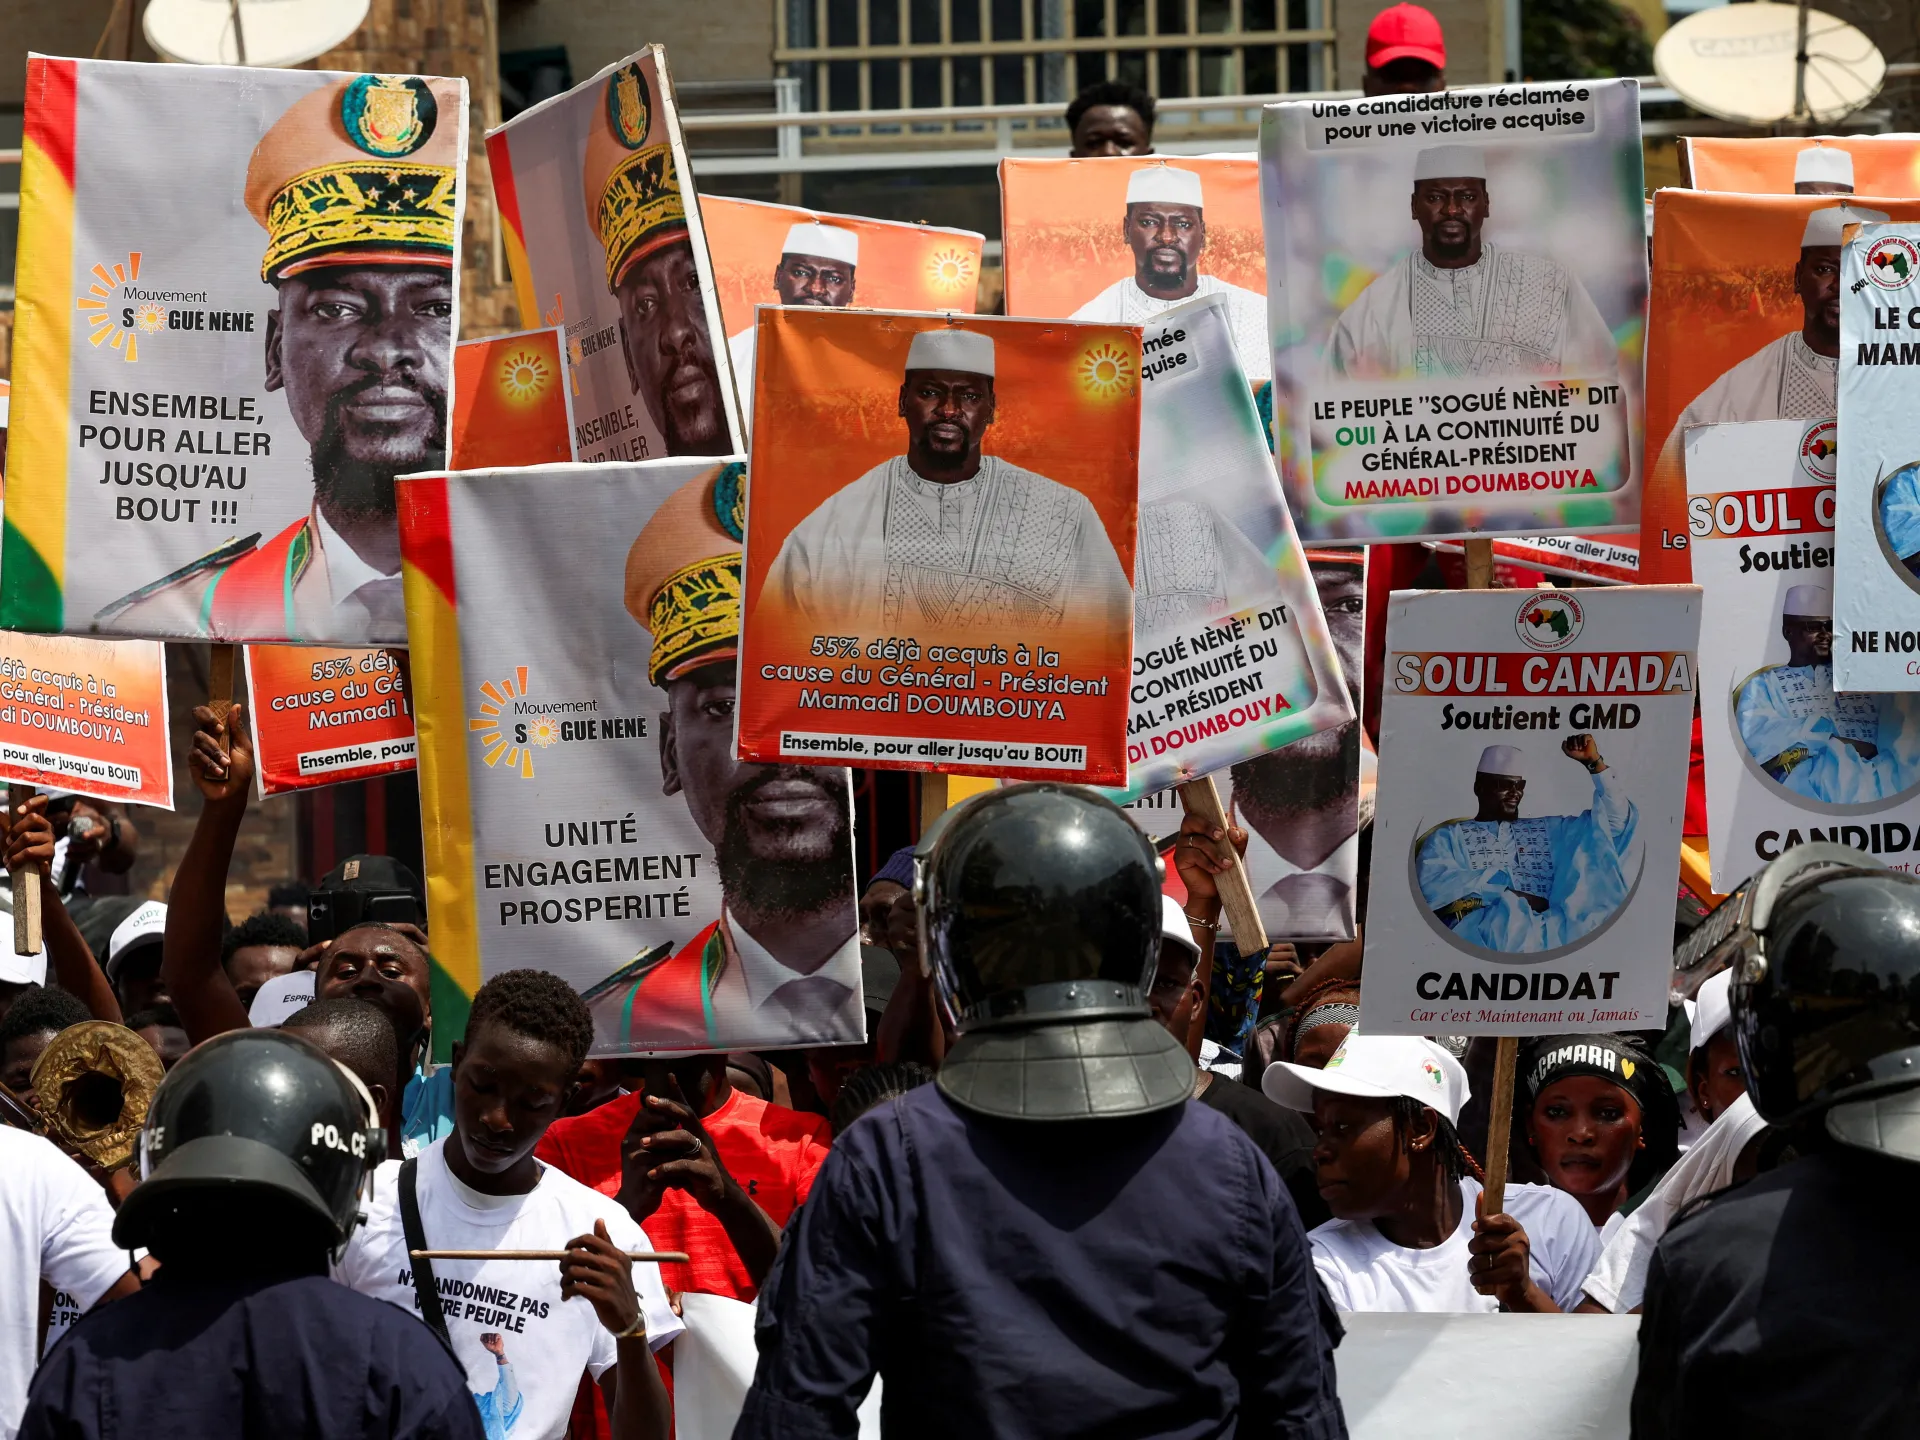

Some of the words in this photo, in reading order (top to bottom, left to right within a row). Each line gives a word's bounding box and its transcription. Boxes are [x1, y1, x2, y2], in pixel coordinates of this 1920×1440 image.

[1312, 102, 1351, 119] Une
[1356, 90, 1483, 116] candidature
[1488, 84, 1590, 109] réclamée
[1325, 124, 1372, 144] pour
[1377, 120, 1416, 137] une
[1421, 113, 1497, 135] victoire
[1502, 108, 1586, 133] acquise
[123, 286, 208, 303] Mouvement
[1850, 278, 1869, 295] SOUL
[565, 316, 594, 338] ouvement
[1874, 307, 1900, 330] LE
[89, 390, 264, 425] ENSEMBLE,
[1314, 401, 1336, 420] LE
[1341, 396, 1414, 419] PEUPLE
[1587, 385, 1619, 406] DIT
[79, 424, 166, 453] POUR
[174, 430, 271, 456] ALLER
[575, 404, 639, 450] NSEMBLE,
[1335, 426, 1376, 446] OUI
[1382, 420, 1399, 443] À
[1405, 423, 1431, 442] LA
[1437, 410, 1564, 441] CONTINUITÉ
[1570, 413, 1600, 434] DU
[1361, 441, 1577, 472] GÉNÉRAL-PRÉSIDENT
[99, 461, 247, 491] JUSQU'AU
[1344, 476, 1439, 500] MAMADI
[1445, 468, 1598, 495] DOUMBOUYA
[116, 496, 201, 523] BOUT
[211, 500, 238, 525] !!!
[1687, 493, 1801, 537] SOUL
[1538, 535, 1571, 551] pour
[1574, 542, 1603, 558] aller
[1661, 530, 1688, 550] Le
[1257, 605, 1289, 631] DIT
[810, 636, 861, 659] 55%
[866, 638, 922, 664] déjà
[928, 645, 1008, 669] acquis
[1013, 643, 1031, 666] à
[1036, 647, 1060, 668] la
[1851, 631, 1879, 653] NE
[31, 668, 83, 692] acquis
[87, 674, 98, 695] à
[101, 679, 116, 699] la
[311, 657, 355, 681] 55%
[760, 663, 834, 684] cause
[841, 664, 871, 685] du
[879, 665, 976, 690] Général
[999, 671, 1109, 697] Président
[1130, 645, 1247, 705] CONTINUITÉ
[1250, 637, 1279, 663] DU
[1395, 655, 1508, 693] SOUL
[1522, 655, 1693, 693] CANADA
[1, 682, 65, 710] Général
[79, 697, 149, 727] Président
[271, 688, 336, 711] cause
[341, 681, 368, 700] du
[514, 700, 598, 715] Mouvement
[798, 688, 900, 713] Mamadi
[905, 694, 1066, 721] DOUMBOUYA
[20, 708, 126, 745] DOUMBOUYA
[309, 700, 397, 730] Mamadi
[601, 715, 648, 740] NÈNÈ
[1150, 692, 1292, 756] DOUMBOUYA
[1440, 702, 1560, 731] Soutient
[1568, 703, 1641, 730] GMD
[300, 747, 377, 770] Ensemble,
[381, 741, 415, 760] pour
[782, 734, 869, 755] Ensemble,
[873, 740, 913, 757] pour
[917, 741, 953, 757] aller
[956, 742, 1030, 763] jusqu'au
[1034, 746, 1083, 763] BOUT!
[3, 748, 29, 760] pour
[32, 752, 56, 767] aller
[59, 756, 105, 777] jusqu'au
[108, 765, 140, 783] BOUT!
[544, 812, 638, 848] UNITÉ
[484, 853, 702, 889] ENGAGEMENT
[500, 885, 690, 927] PROSPERITÉ
[1416, 971, 1620, 1001] CANDIDAT
[1410, 1008, 1438, 1022] Car
[1440, 1008, 1471, 1022] c'est
[1476, 1008, 1563, 1023] Maintenant
[1567, 1013, 1585, 1022] ou
[1588, 1007, 1639, 1024] Jamais
[464, 1303, 526, 1334] PEUPLE
[520, 1297, 550, 1319] PAS
